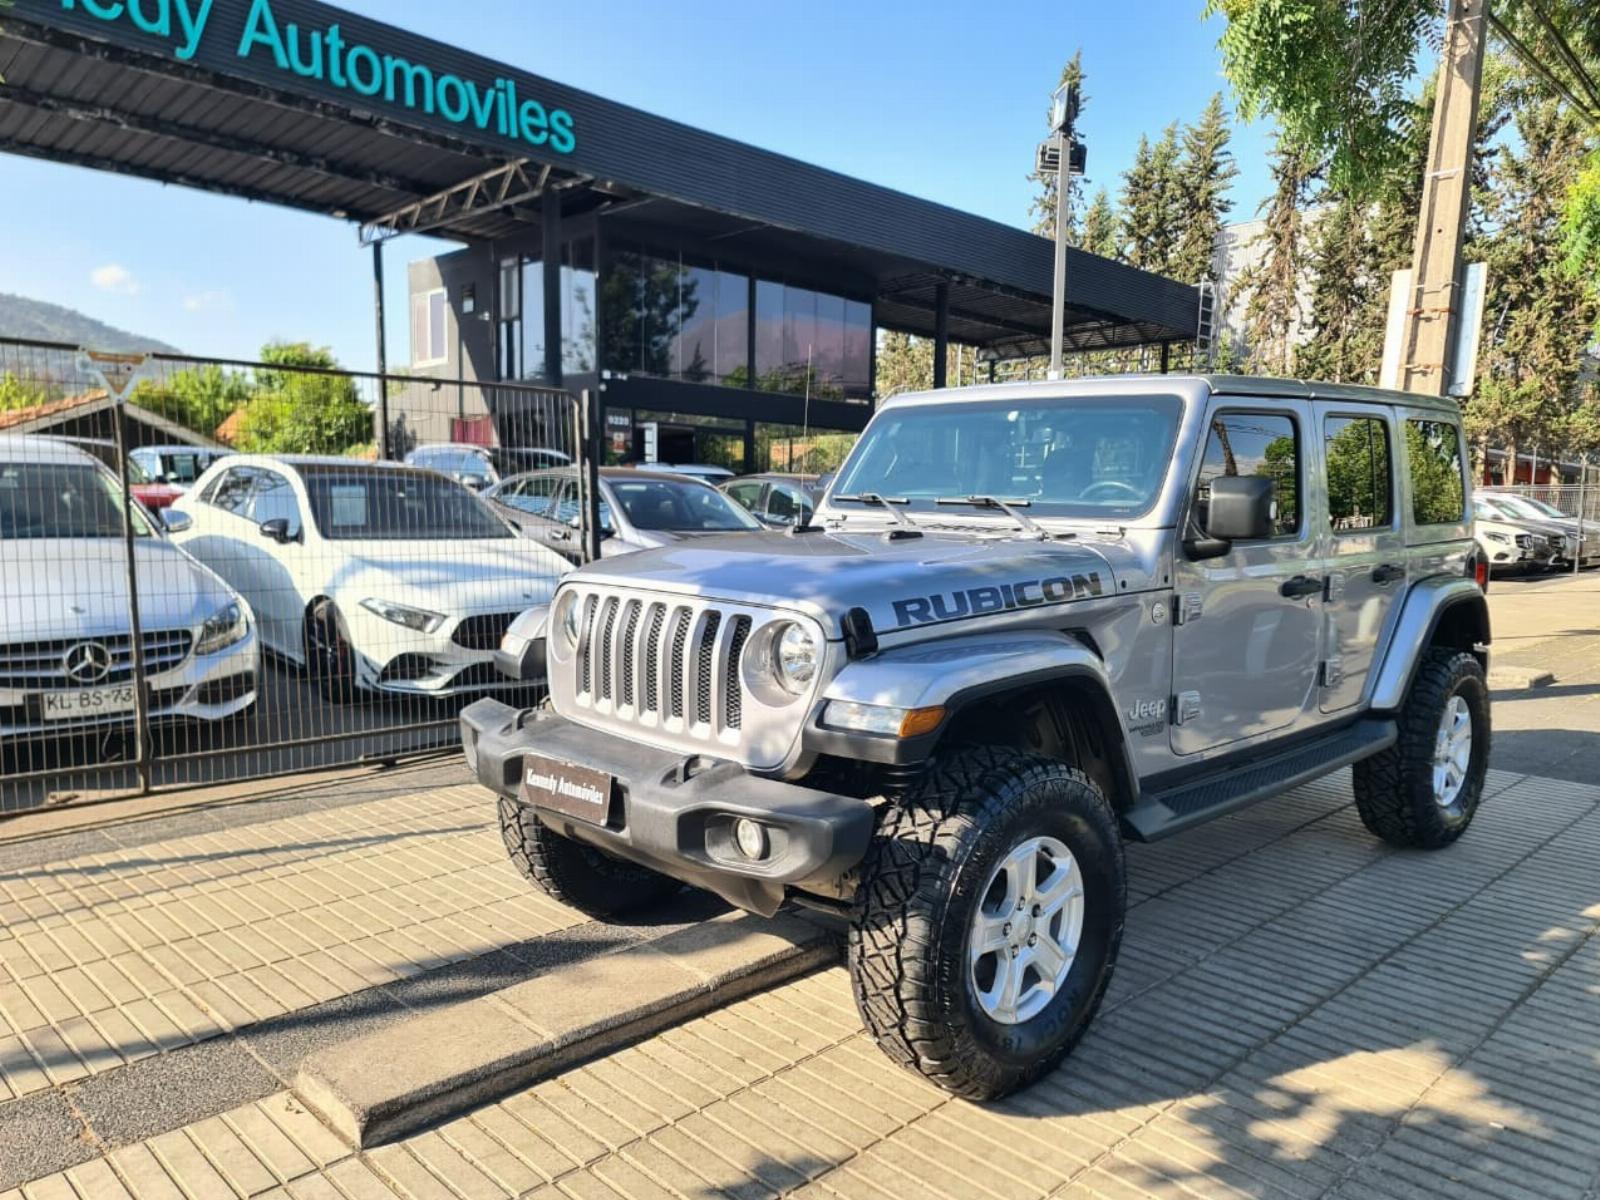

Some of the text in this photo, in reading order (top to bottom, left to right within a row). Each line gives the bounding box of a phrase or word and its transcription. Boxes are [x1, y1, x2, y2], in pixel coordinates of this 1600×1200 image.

[238, 0, 576, 154] Automoviles
[892, 572, 1102, 626] RUBICON
[1129, 699, 1166, 719] Jeep
